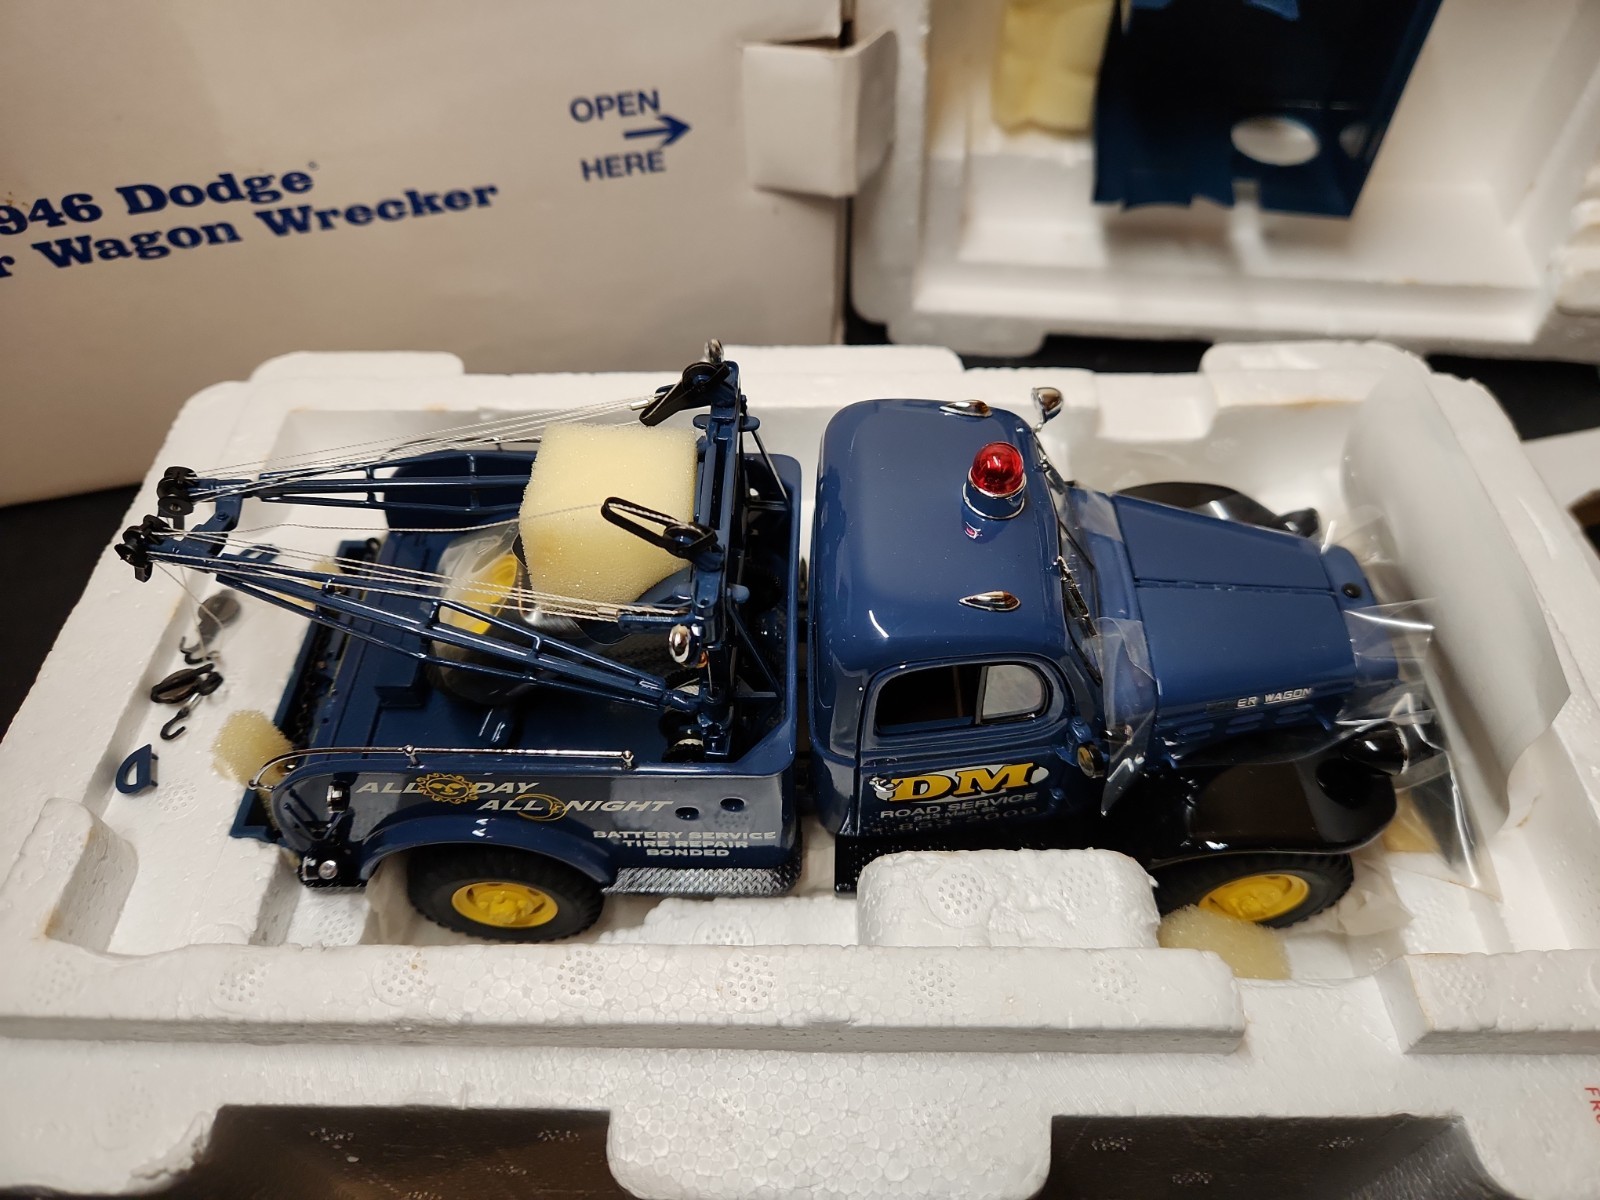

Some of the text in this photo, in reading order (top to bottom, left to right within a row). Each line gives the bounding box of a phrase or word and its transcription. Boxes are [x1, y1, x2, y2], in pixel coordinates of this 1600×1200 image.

[569, 89, 660, 124] OPEN
[580, 150, 666, 182] HERE
[115, 172, 314, 215] Dodge
[31, 221, 243, 268] Wagon
[254, 184, 500, 238] Wrecker
[1264, 687, 1312, 704] WAGON
[355, 781, 539, 794] ALL DAY
[886, 762, 1038, 803] DM
[476, 799, 675, 812] ALL NIGHT
[880, 792, 1039, 819] ROAD SERVICE
[944, 808, 978, 818] Main
[593, 830, 777, 840] BATTERY SERVICE
[623, 839, 749, 849] TIRE REPAIR
[646, 848, 731, 857] BONDED
